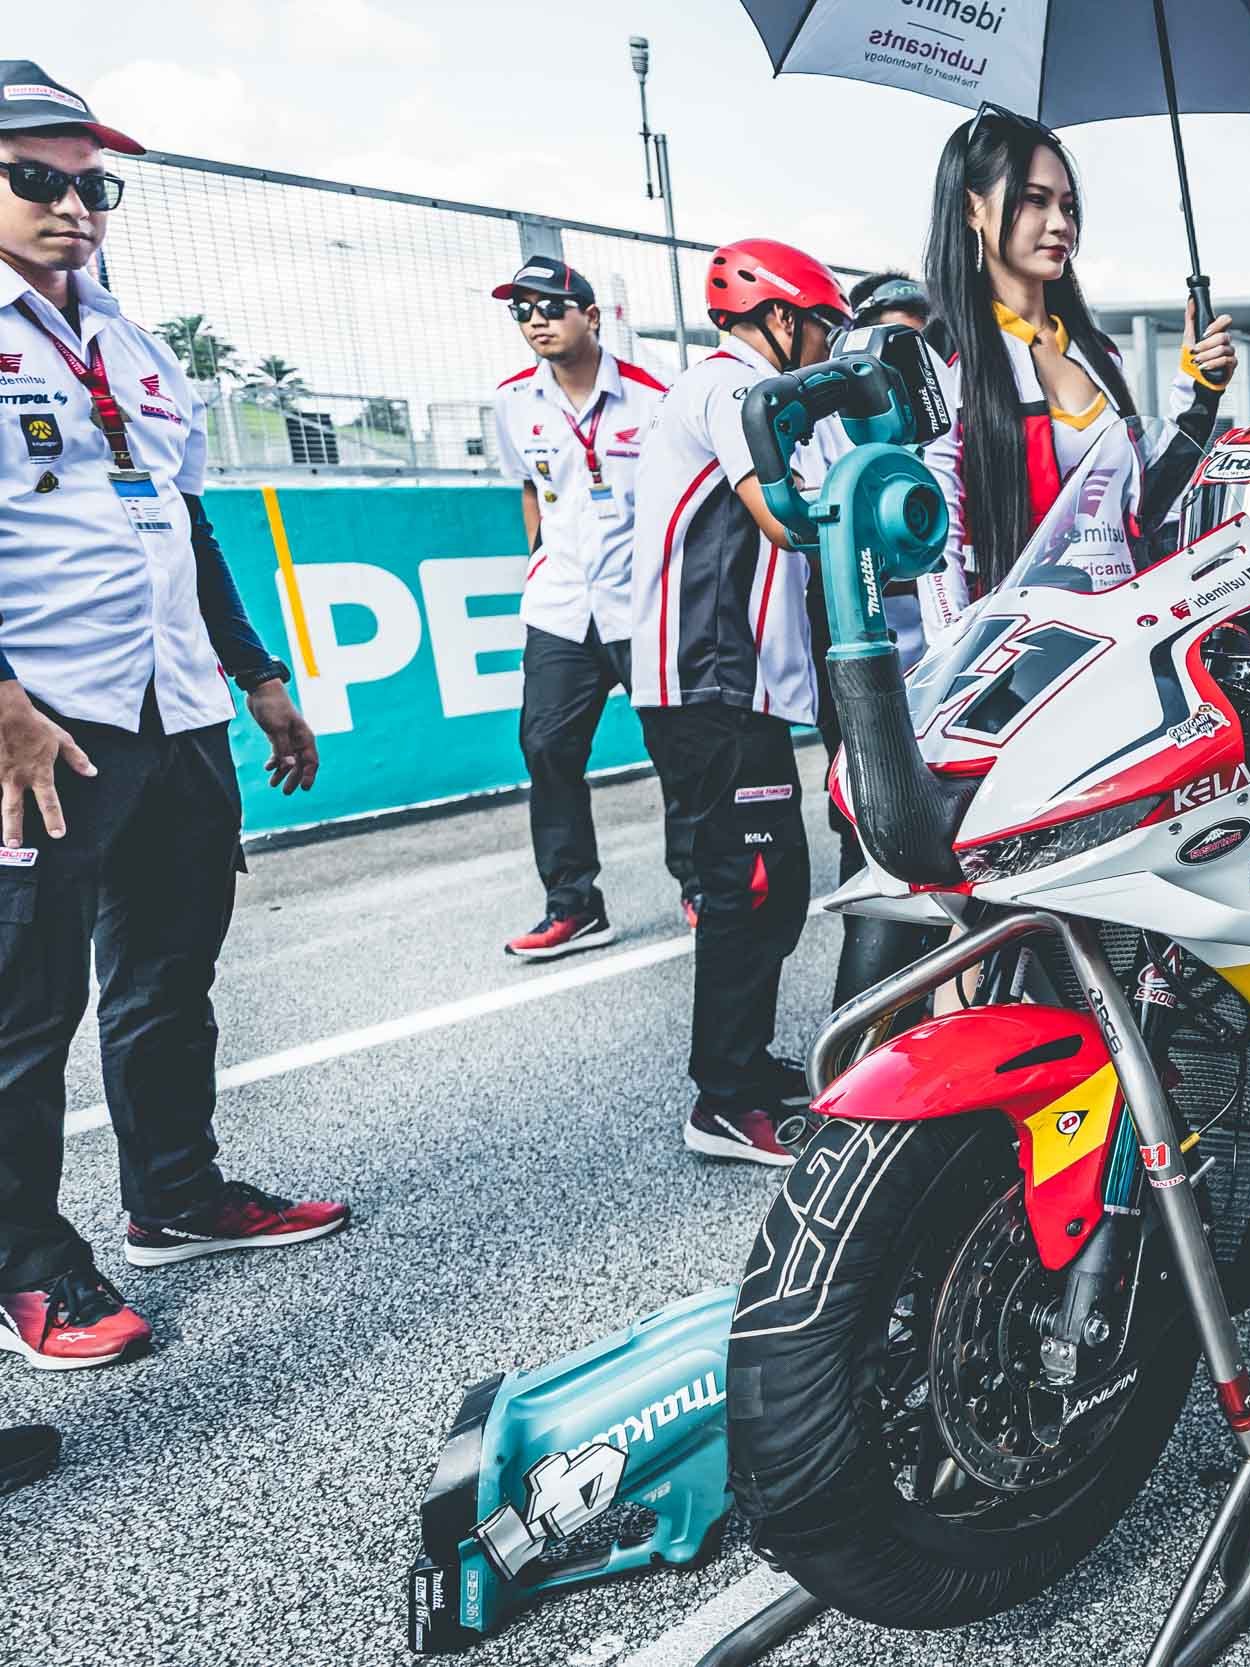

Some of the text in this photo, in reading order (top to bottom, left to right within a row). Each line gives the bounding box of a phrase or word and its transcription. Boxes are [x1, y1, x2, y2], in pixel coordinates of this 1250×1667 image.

[0, 375, 47, 386] demitsu
[859, 547, 881, 618] makita
[932, 574, 952, 625] bricants
[1189, 575, 1245, 609] idemitsu
[432, 1570, 446, 1611] makita
